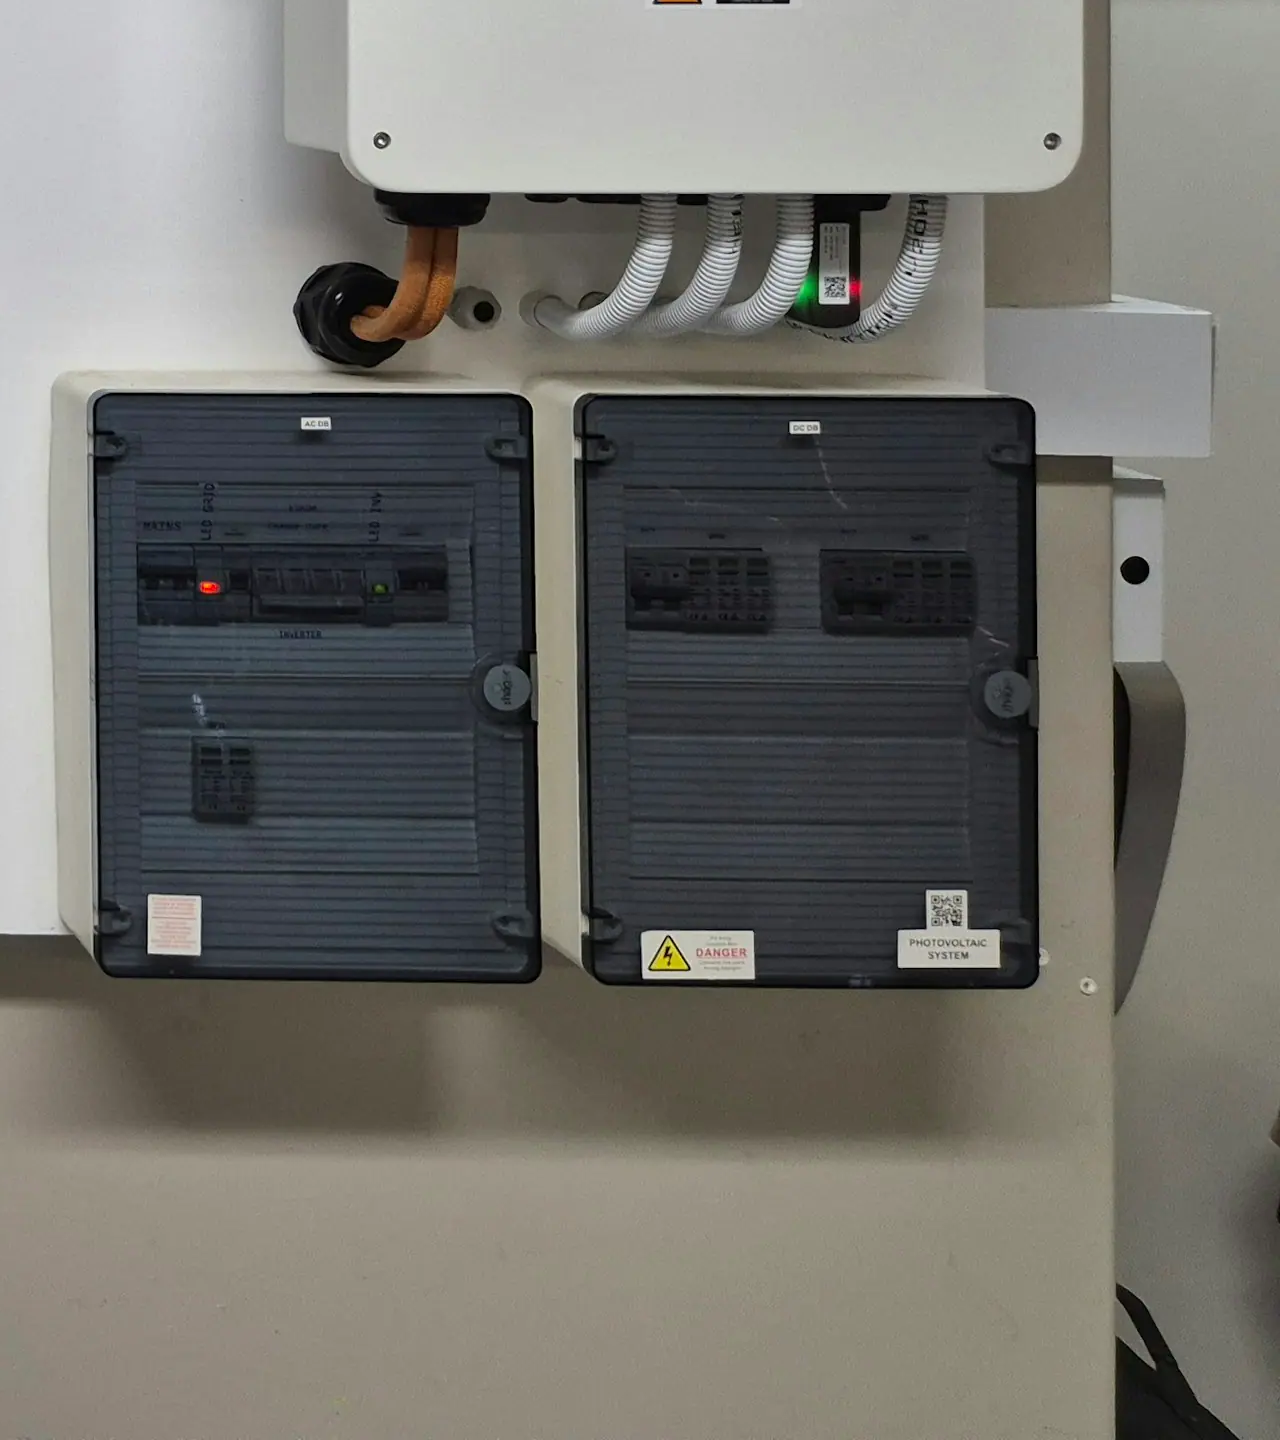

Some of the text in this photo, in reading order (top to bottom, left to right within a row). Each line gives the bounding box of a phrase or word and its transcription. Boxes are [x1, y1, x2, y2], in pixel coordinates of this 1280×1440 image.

[200, 483, 216, 541] LED GRID
[368, 521, 380, 542] LED
[909, 938, 988, 948] PHOTOVOLTAIC
[696, 947, 748, 957] DANGER
[927, 951, 970, 960] SYSTEM
